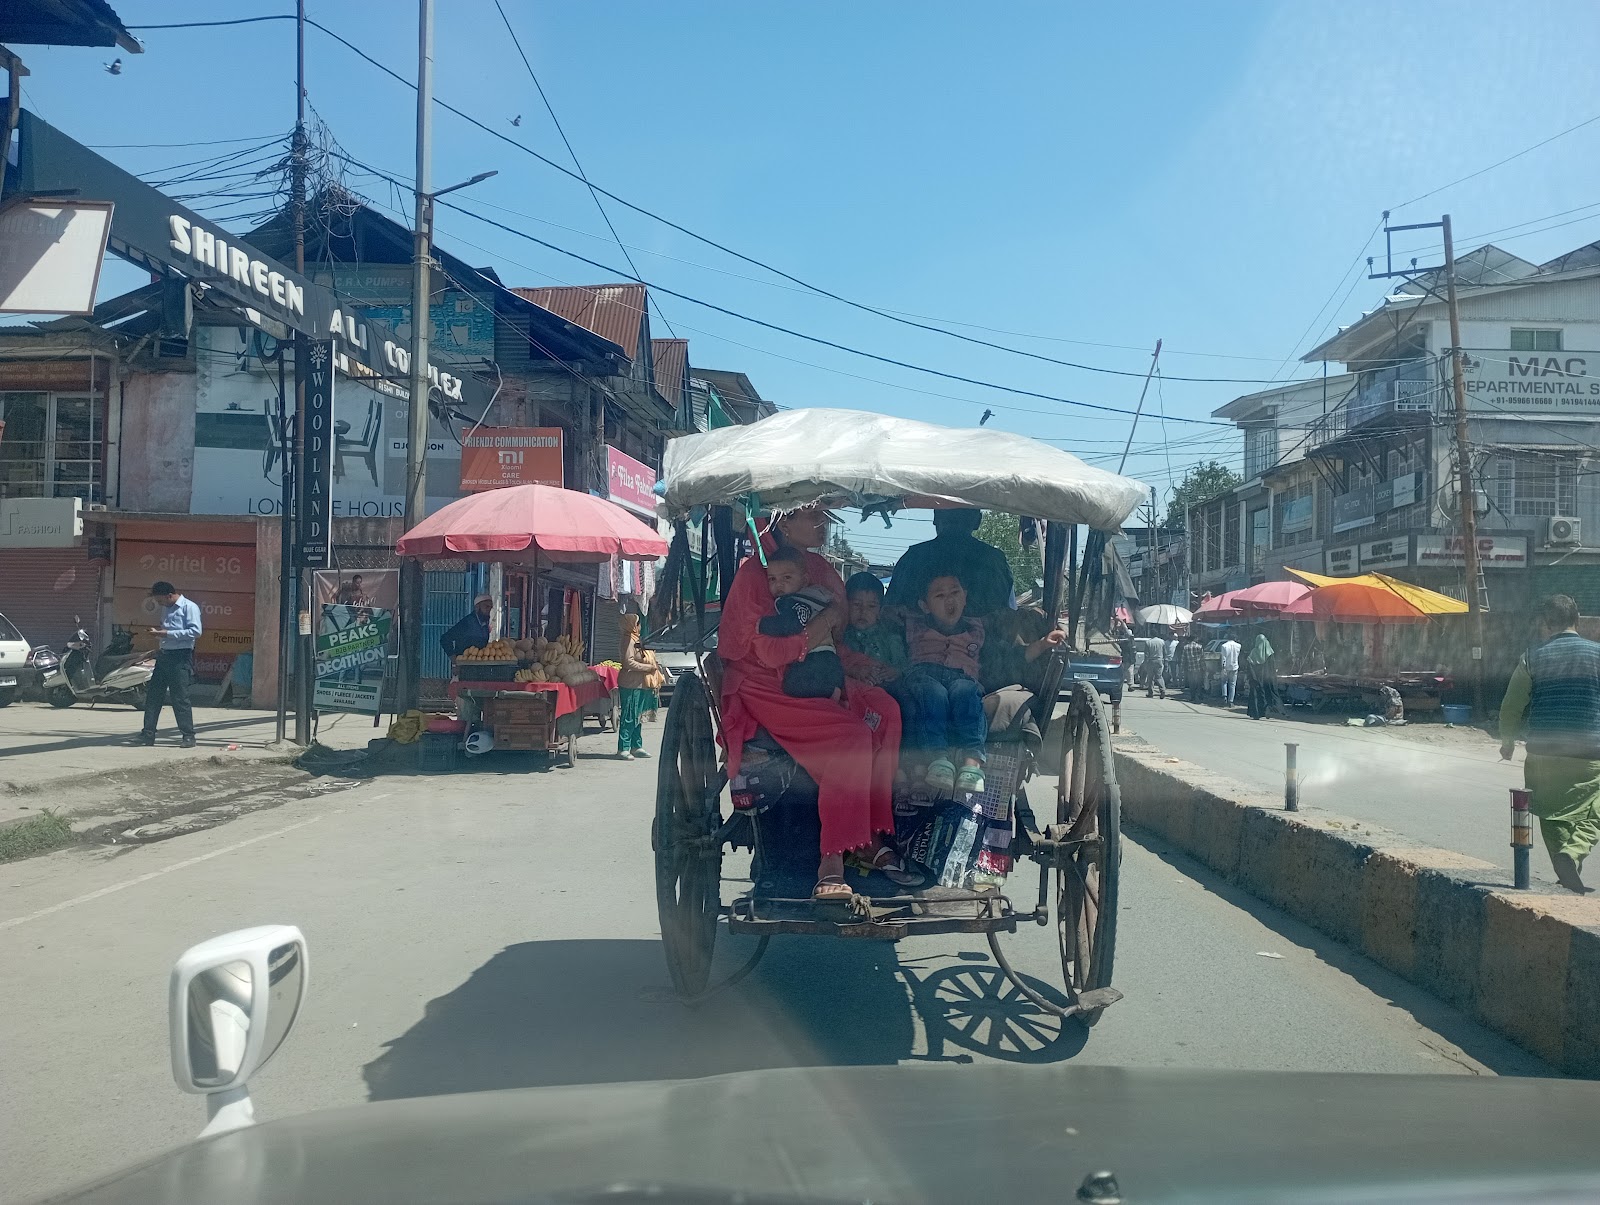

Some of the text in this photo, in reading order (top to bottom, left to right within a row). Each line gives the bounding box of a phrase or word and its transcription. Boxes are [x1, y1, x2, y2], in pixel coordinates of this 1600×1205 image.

[365, 276, 406, 287] PUMPS
[169, 214, 304, 316] SHIREEN
[329, 308, 368, 351] ALI
[384, 340, 464, 402] COLEX
[1508, 356, 1587, 378] MAC
[494, 436, 559, 448] COMMUNICATION
[310, 371, 325, 537] WOODLAND
[19, 525, 61, 535] FASHION
[158, 553, 241, 574] airtel 3G
[213, 631, 252, 644] Premium
[329, 624, 378, 646] PEAKS
[317, 647, 384, 676] DECATHLON
